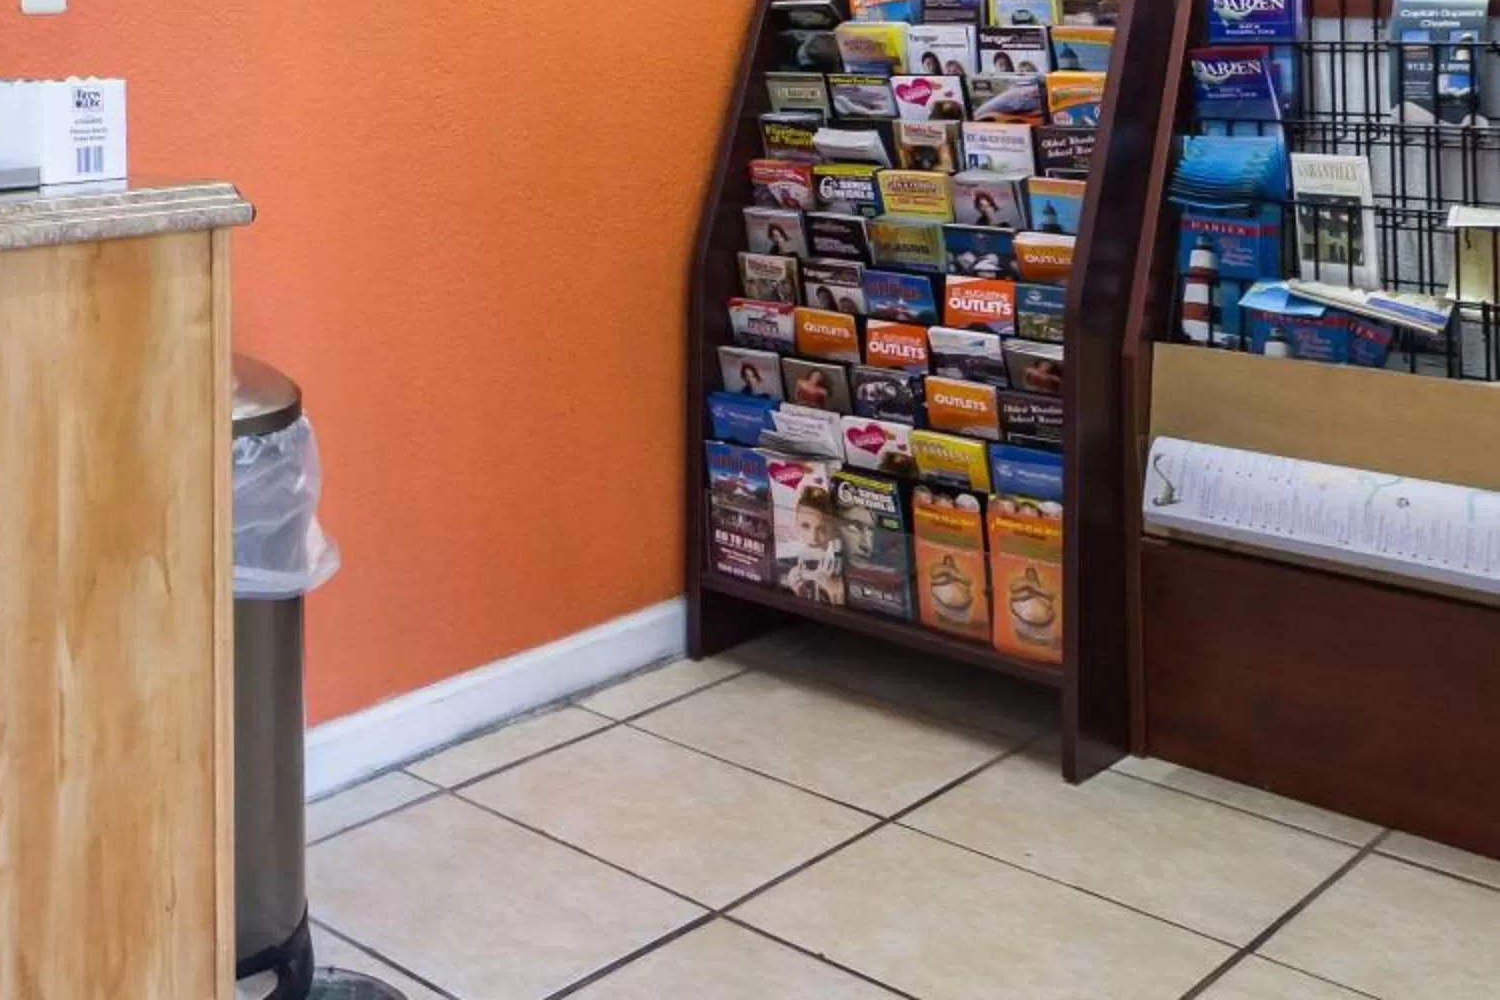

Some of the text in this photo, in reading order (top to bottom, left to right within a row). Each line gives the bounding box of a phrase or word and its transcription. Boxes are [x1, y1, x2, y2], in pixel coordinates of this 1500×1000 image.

[1024, 253, 1073, 265] OUTLET
[949, 297, 1013, 315] OUTLETS
[803, 320, 851, 339] OUTLETS
[868, 341, 925, 359] OUTLETS
[933, 392, 988, 412] OUTLETS
